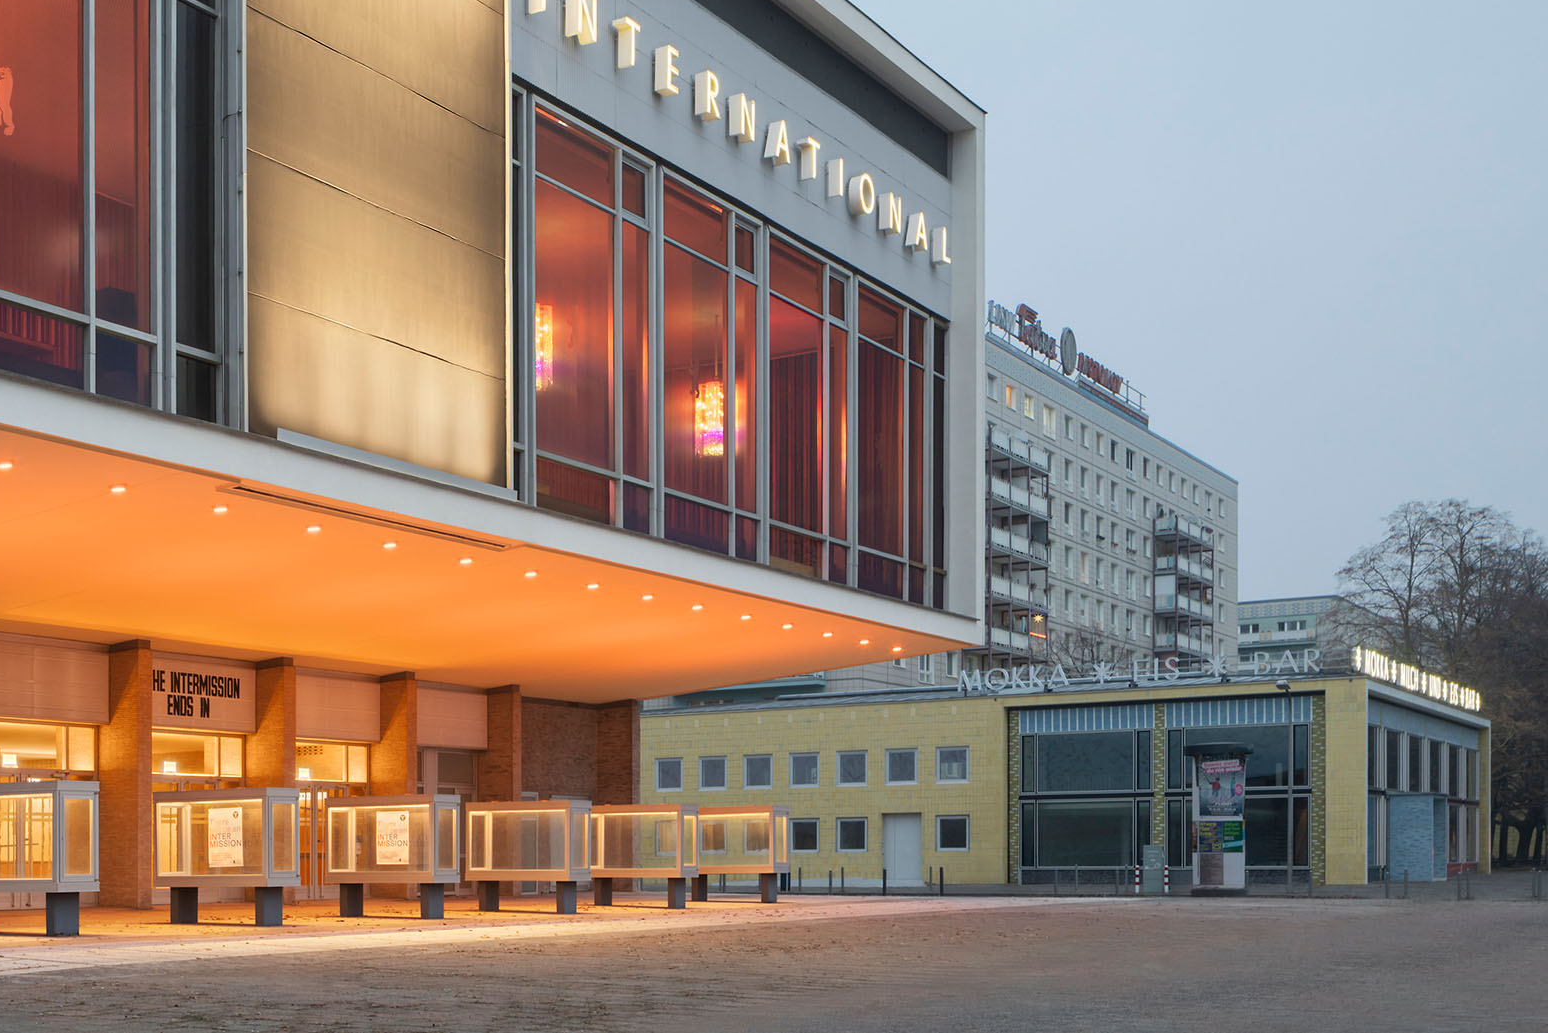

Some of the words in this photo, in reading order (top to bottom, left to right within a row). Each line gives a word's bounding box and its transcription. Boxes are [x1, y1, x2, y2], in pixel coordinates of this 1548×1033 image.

[957, 663, 1070, 692] MOKKA
[1133, 656, 1180, 682] EIS
[1253, 648, 1321, 676] BAR
[152, 669, 166, 692] HE
[170, 671, 241, 699] INTERMISSION
[167, 694, 194, 717] ENDS
[200, 697, 210, 718] IN
[210, 832, 232, 840] INTER
[210, 839, 242, 848] MISSION
[378, 839, 408, 847] MISSION
